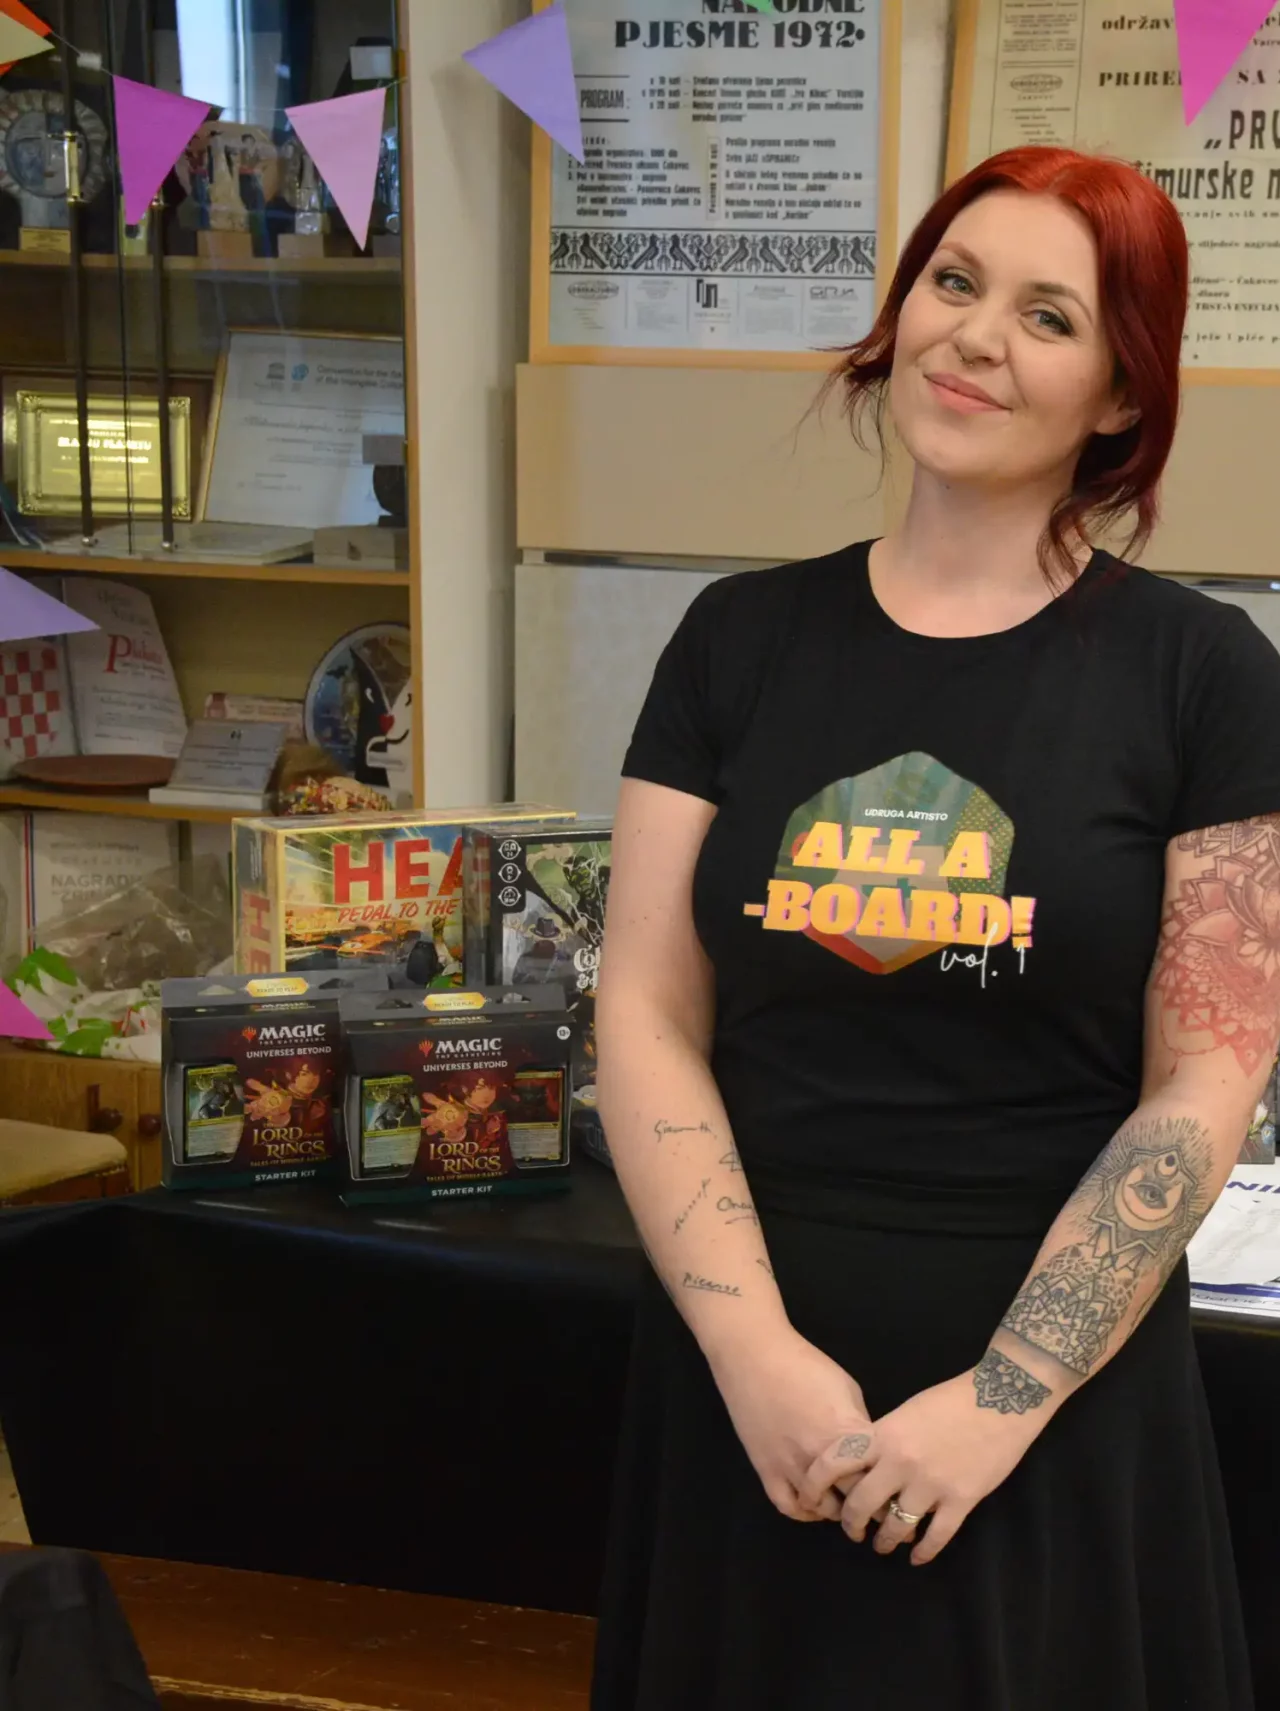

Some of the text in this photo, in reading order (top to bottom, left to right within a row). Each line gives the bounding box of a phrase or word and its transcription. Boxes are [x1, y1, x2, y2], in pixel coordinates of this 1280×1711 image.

[615, 20, 759, 49] PJESME
[1237, 69, 1266, 84] SA
[864, 808, 948, 821] UDRUGA ARTISTO
[792, 821, 991, 879] ALL A
[338, 898, 462, 923] PEDAL TO THE
[940, 922, 1025, 989] vol. 1
[259, 1024, 326, 1041] MAGIC
[246, 1046, 332, 1059] UNIVERSES BEYOND
[435, 1038, 502, 1054] MAGIC
[423, 1060, 508, 1072] UNIVERSES BEYOND
[253, 1126, 303, 1145] LORD
[265, 1139, 325, 1159] RINGS
[429, 1141, 479, 1160] LORD
[441, 1155, 502, 1175] RINGS
[255, 1168, 317, 1182] STARTER KIT
[431, 1185, 493, 1197] STARTER KIT
